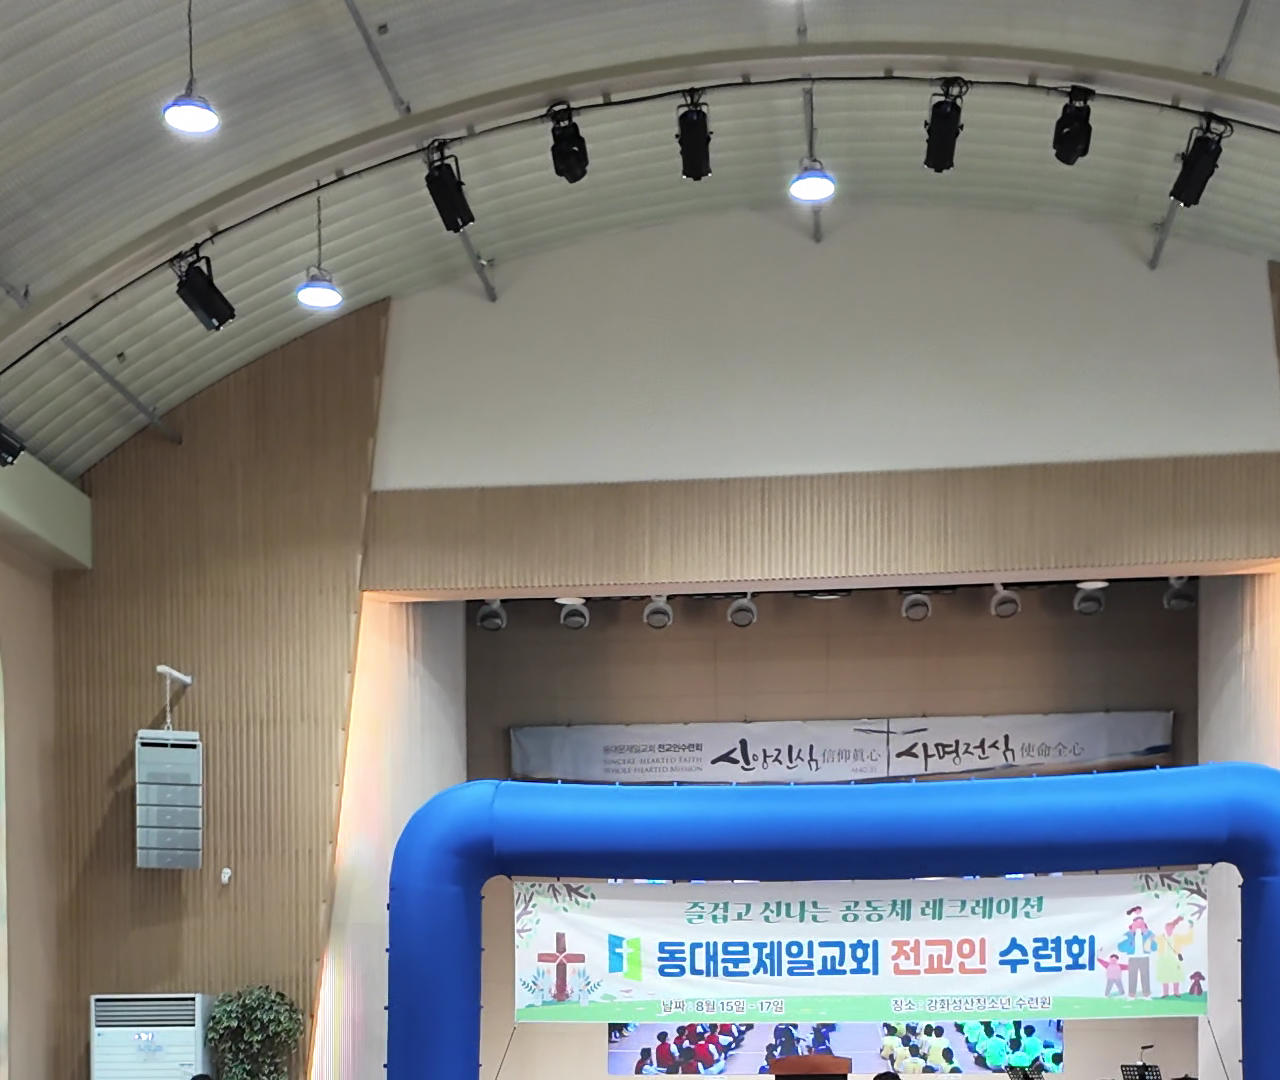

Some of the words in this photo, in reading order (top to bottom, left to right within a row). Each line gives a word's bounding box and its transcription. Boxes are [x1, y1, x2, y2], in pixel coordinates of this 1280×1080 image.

[684, 900, 753, 925] 즐겁고
[759, 899, 832, 924] 신나는
[839, 898, 912, 923] 공동체
[920, 895, 1044, 921] 레크레이션
[656, 939, 879, 978] 동대문제일교회
[891, 937, 987, 976] 전교인
[998, 935, 1097, 974] 수련회
[696, 1000, 715, 1013] 8월
[720, 1000, 745, 1013] 15일
[759, 1000, 784, 1013] 17일
